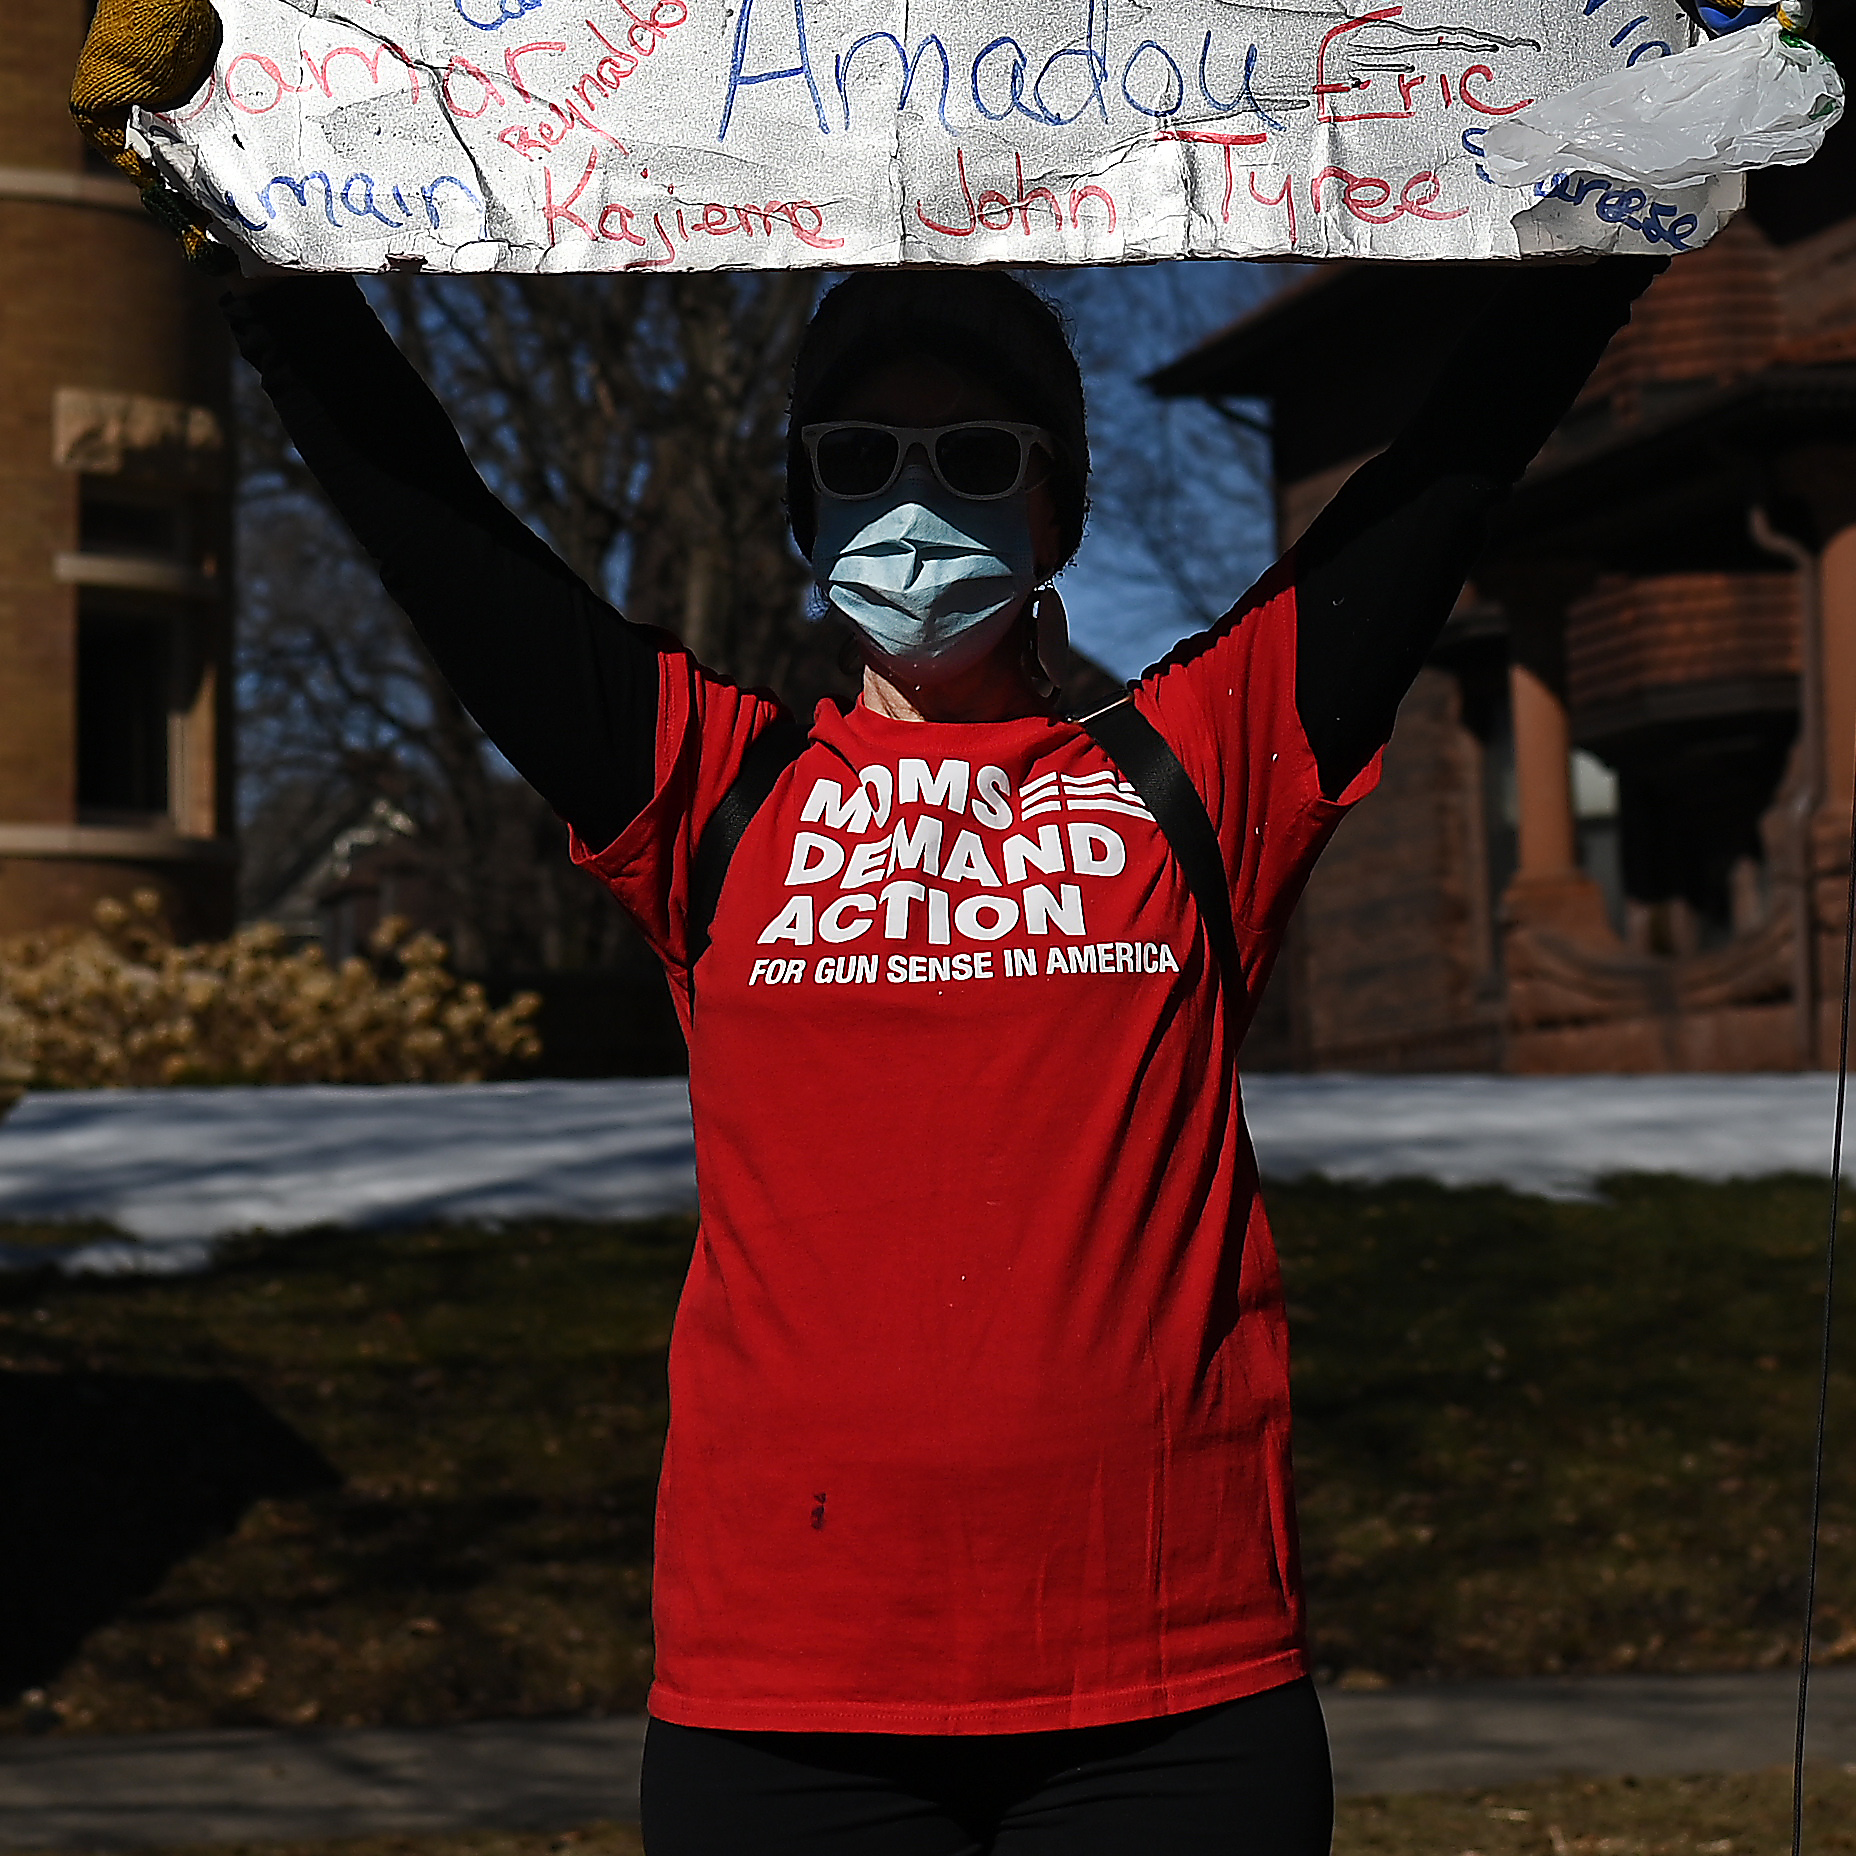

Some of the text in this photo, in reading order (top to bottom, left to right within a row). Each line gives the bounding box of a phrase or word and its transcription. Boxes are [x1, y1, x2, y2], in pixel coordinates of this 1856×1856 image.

[1312, 7, 1534, 123] Eric
[917, 148, 1116, 237] John
[1154, 131, 1469, 246] Tyree
[800, 758, 1013, 834] MOMS
[784, 815, 1125, 889] DEMAND
[757, 881, 1086, 944] ACTION
[748, 942, 1179, 986] FOR GUN SENSE IN AMERICA
